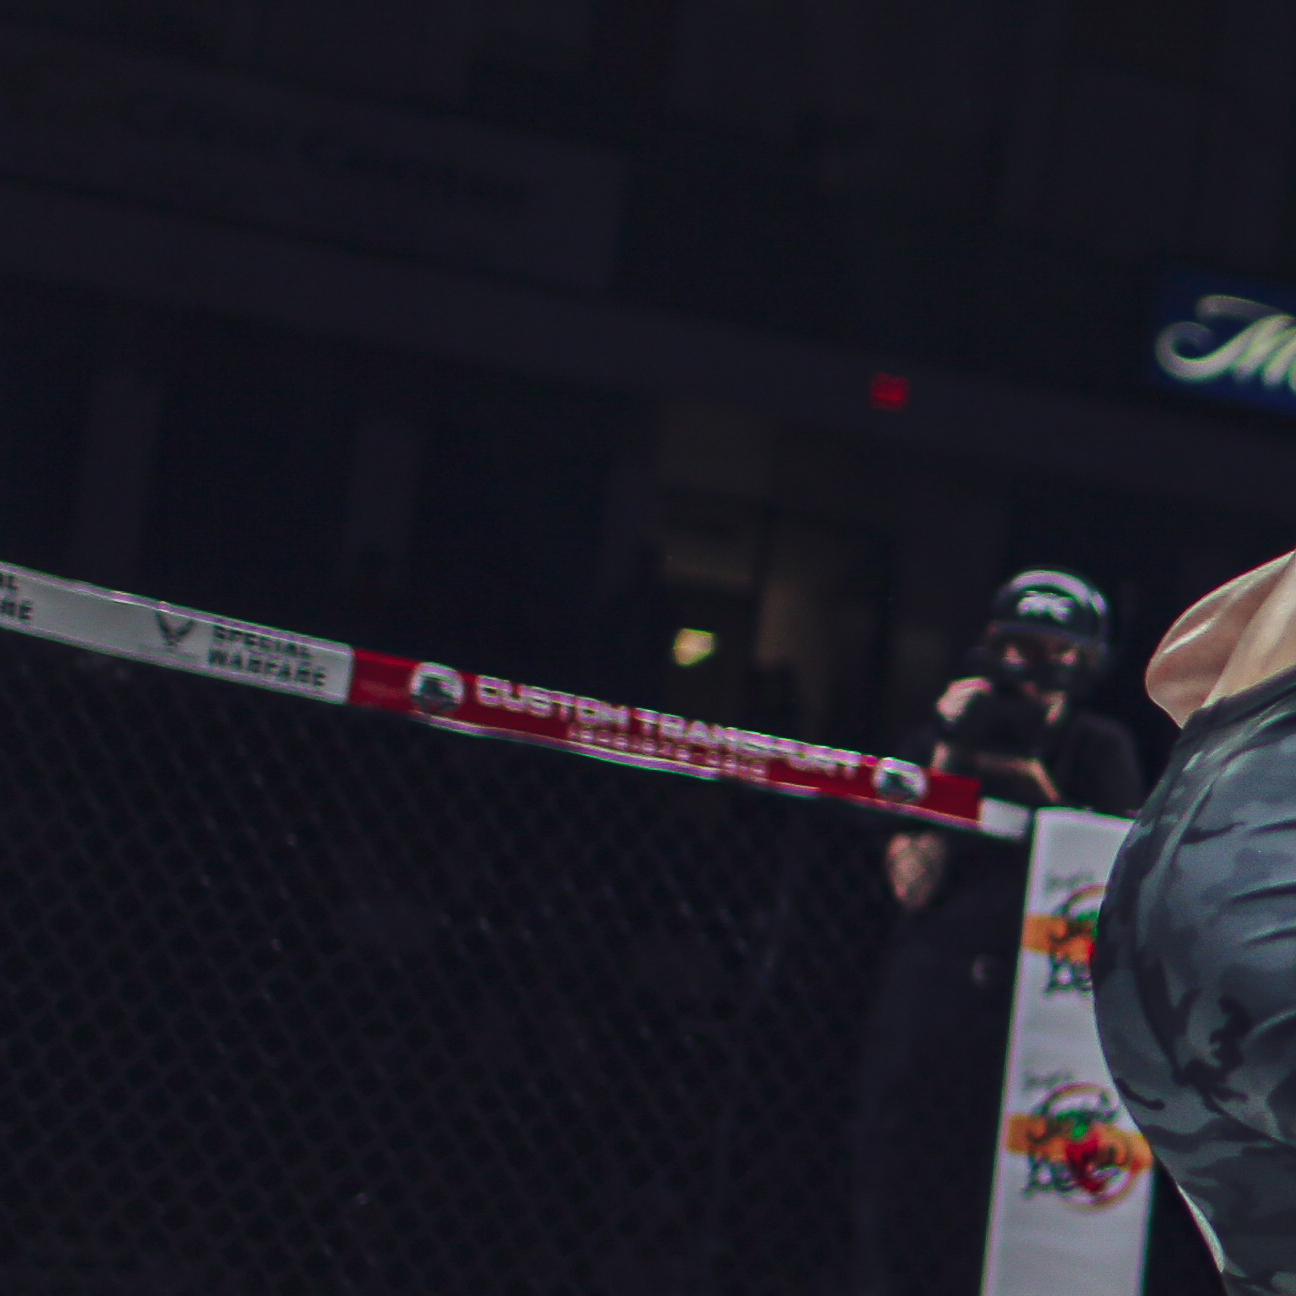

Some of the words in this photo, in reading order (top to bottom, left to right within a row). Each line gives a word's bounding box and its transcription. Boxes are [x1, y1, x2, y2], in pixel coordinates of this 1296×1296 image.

[211, 622, 314, 659] SPECIAL
[208, 649, 328, 688] WARFARE
[476, 675, 631, 732] CUSTOM
[634, 707, 863, 780] TRANSPORT
